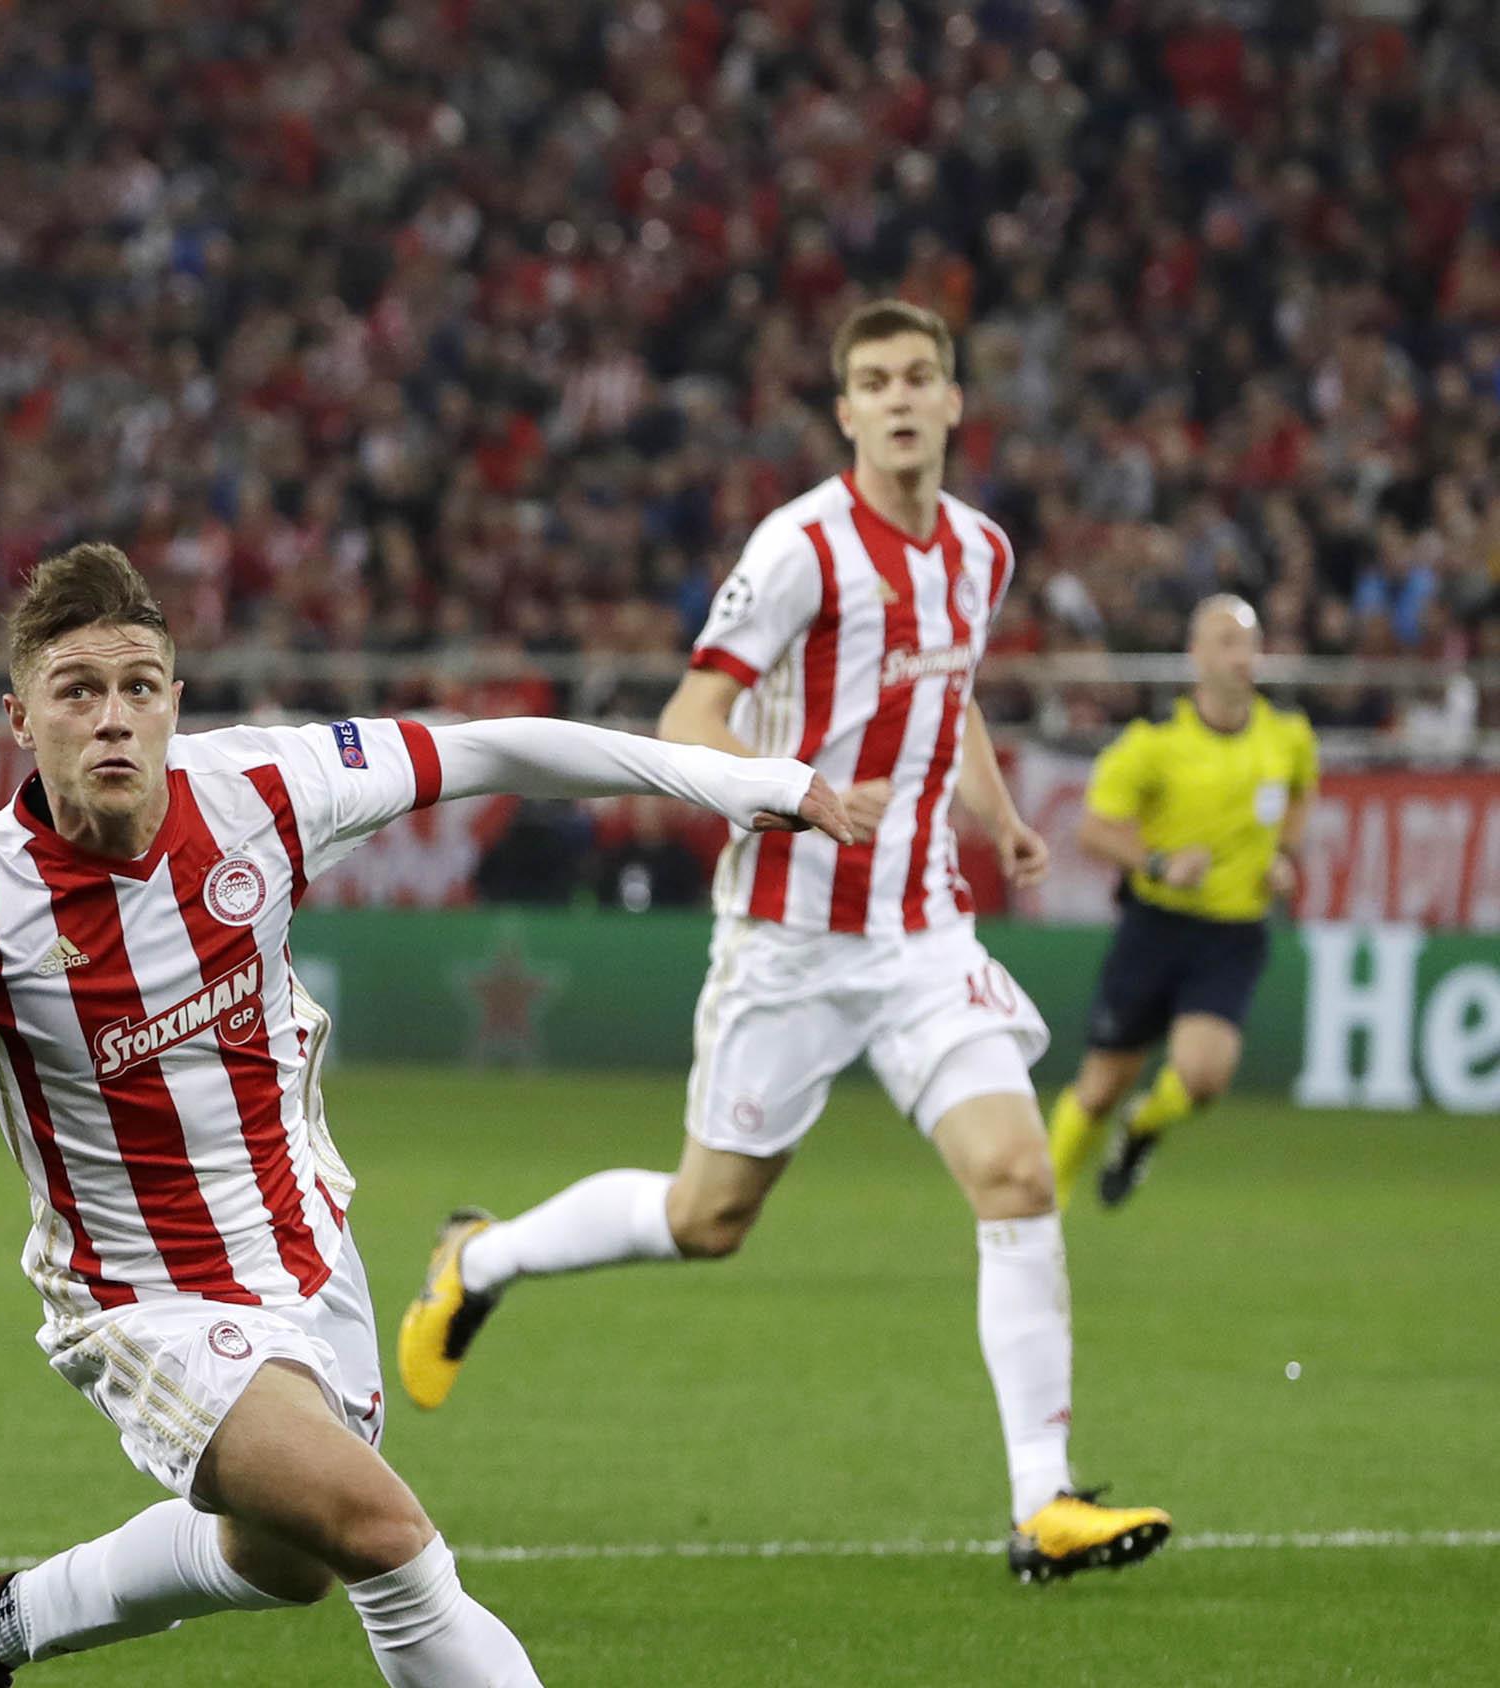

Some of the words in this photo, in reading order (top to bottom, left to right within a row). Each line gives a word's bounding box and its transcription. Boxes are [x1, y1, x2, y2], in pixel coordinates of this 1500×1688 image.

[38, 952, 91, 976] adidas
[100, 960, 259, 1075] STOIXIMAN
[228, 1006, 255, 1031] GR
[1295, 921, 1500, 1112] He
